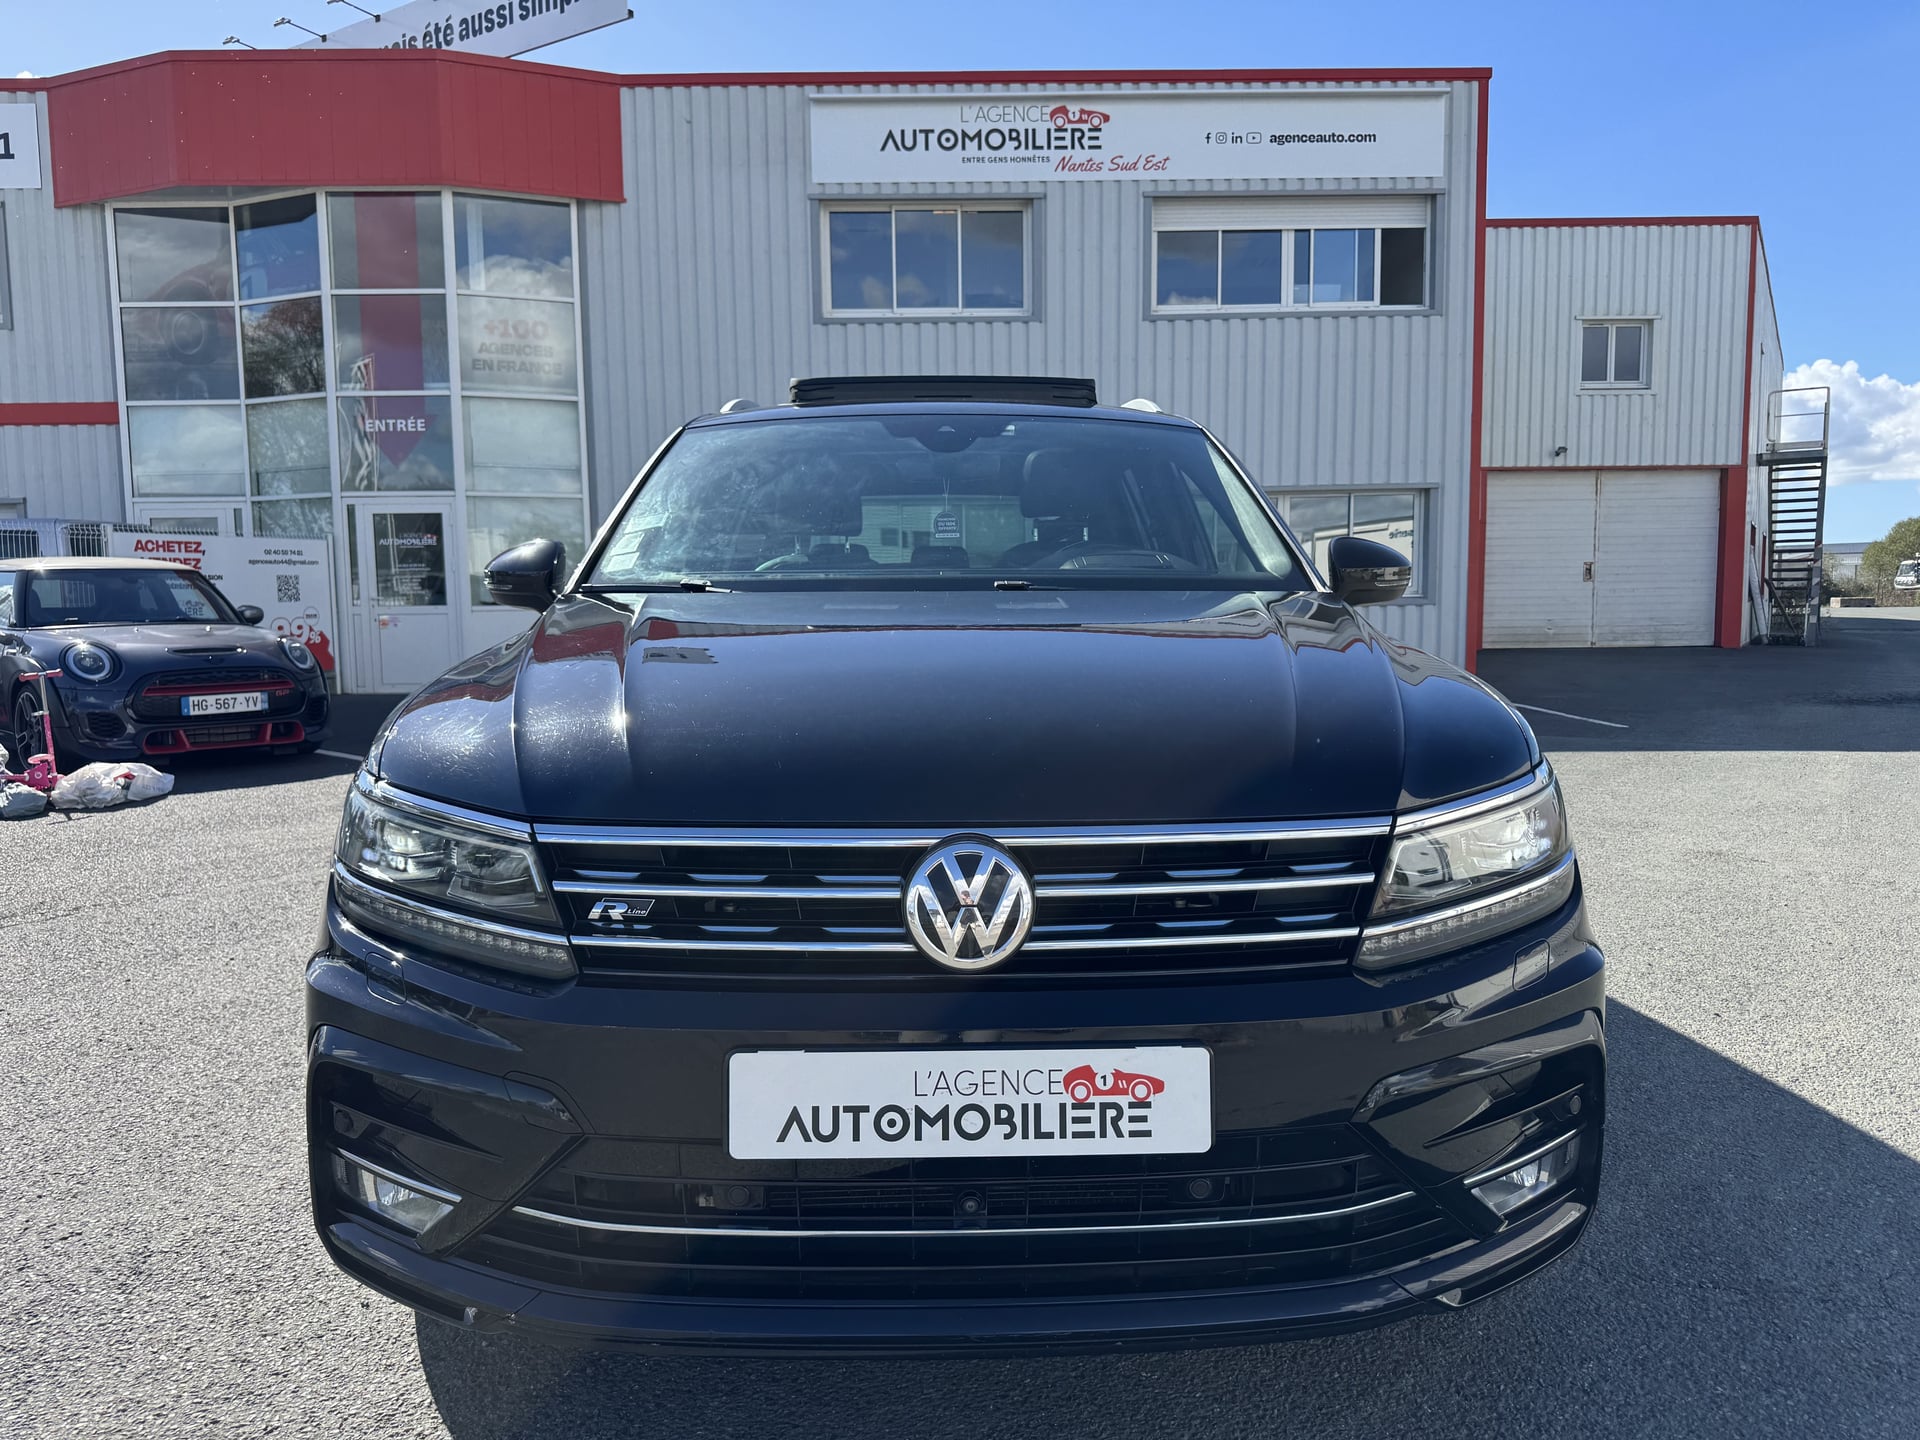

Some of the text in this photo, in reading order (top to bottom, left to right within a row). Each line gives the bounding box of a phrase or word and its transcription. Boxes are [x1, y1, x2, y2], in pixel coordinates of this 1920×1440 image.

[422, 14, 455, 49] été
[458, 7, 514, 42] aussi
[960, 105, 1050, 123] L'AGENCE
[1269, 132, 1377, 146] agenceauto.com
[962, 154, 1050, 164] ENTRE GENS HONNÊTES
[1055, 154, 1172, 172] Nantes Sud Est
[478, 342, 554, 358] AGENCES
[471, 358, 563, 376] EN FRANCE
[365, 416, 427, 432] ENTRÉE
[134, 539, 206, 556] ACHETEZ,
[192, 696, 259, 712] HG-567-YV
[588, 902, 647, 920] R Line
[914, 1069, 1063, 1097] L'AGENCE
